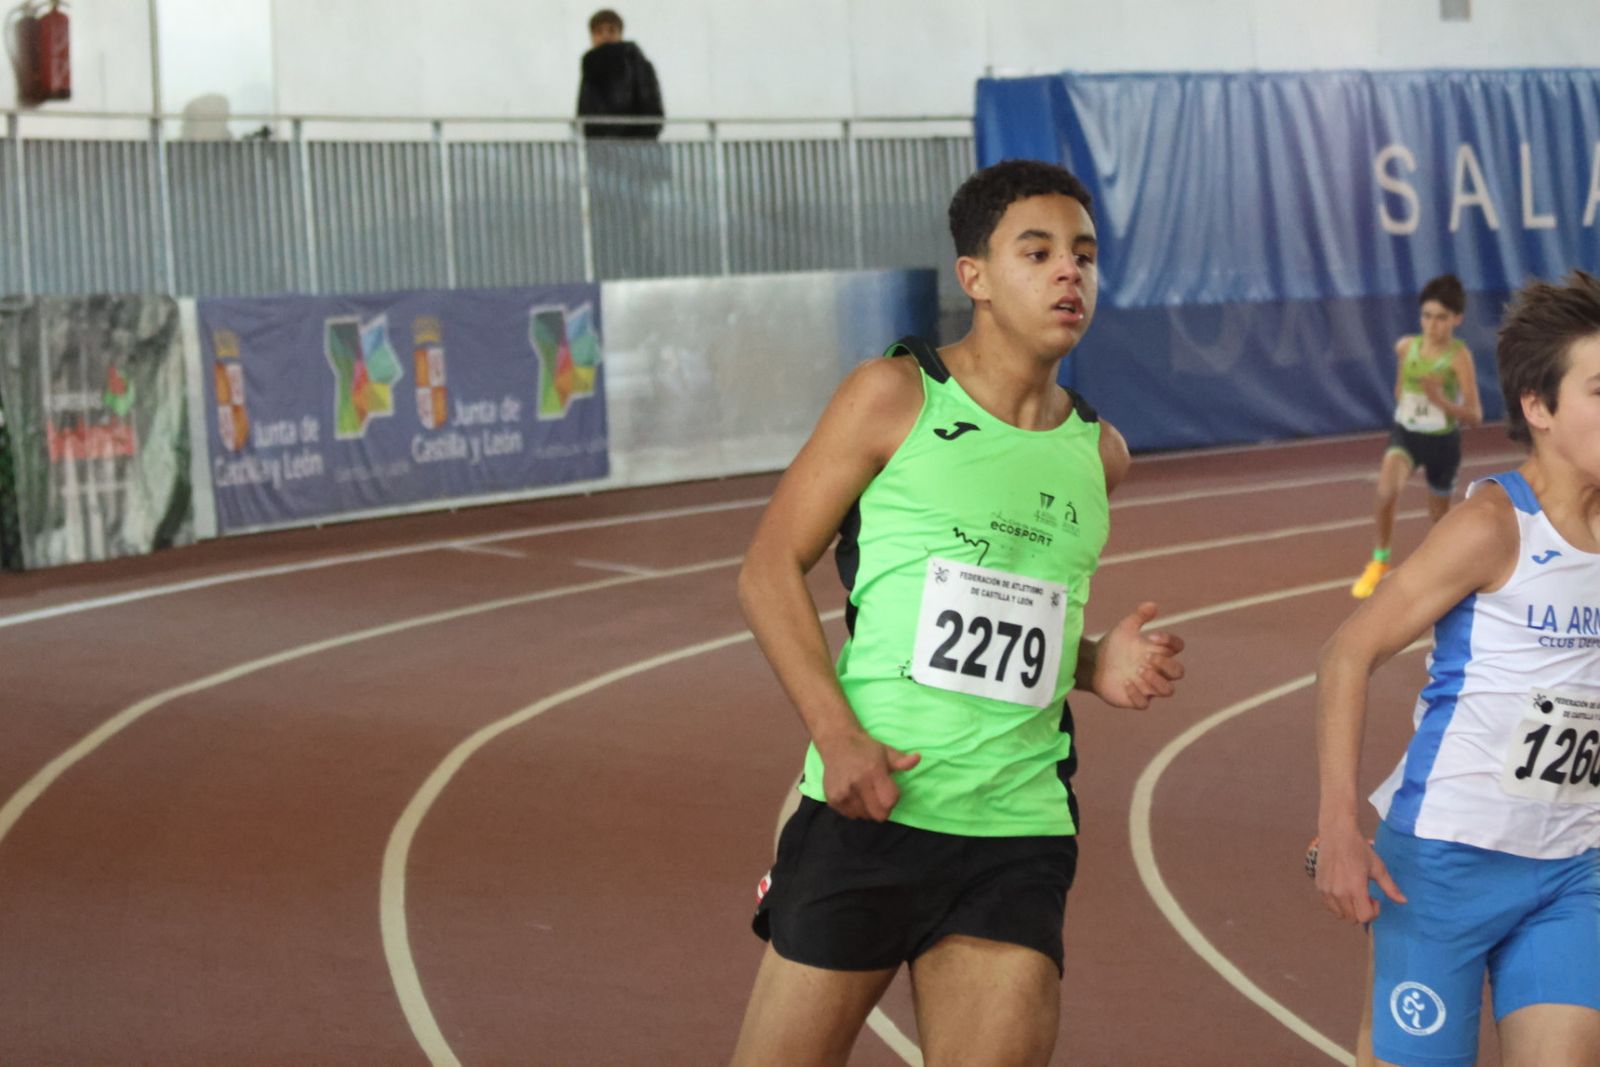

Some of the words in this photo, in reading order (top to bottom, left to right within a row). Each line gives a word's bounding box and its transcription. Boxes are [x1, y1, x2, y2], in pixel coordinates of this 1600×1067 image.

[970, 586, 981, 597] DE
[981, 589, 1011, 602] CASTILLA
[1002, 579, 1011, 590] DE
[1011, 582, 1044, 596] ATLETISMO
[1527, 604, 1558, 633] LA
[928, 608, 1047, 690] 2279
